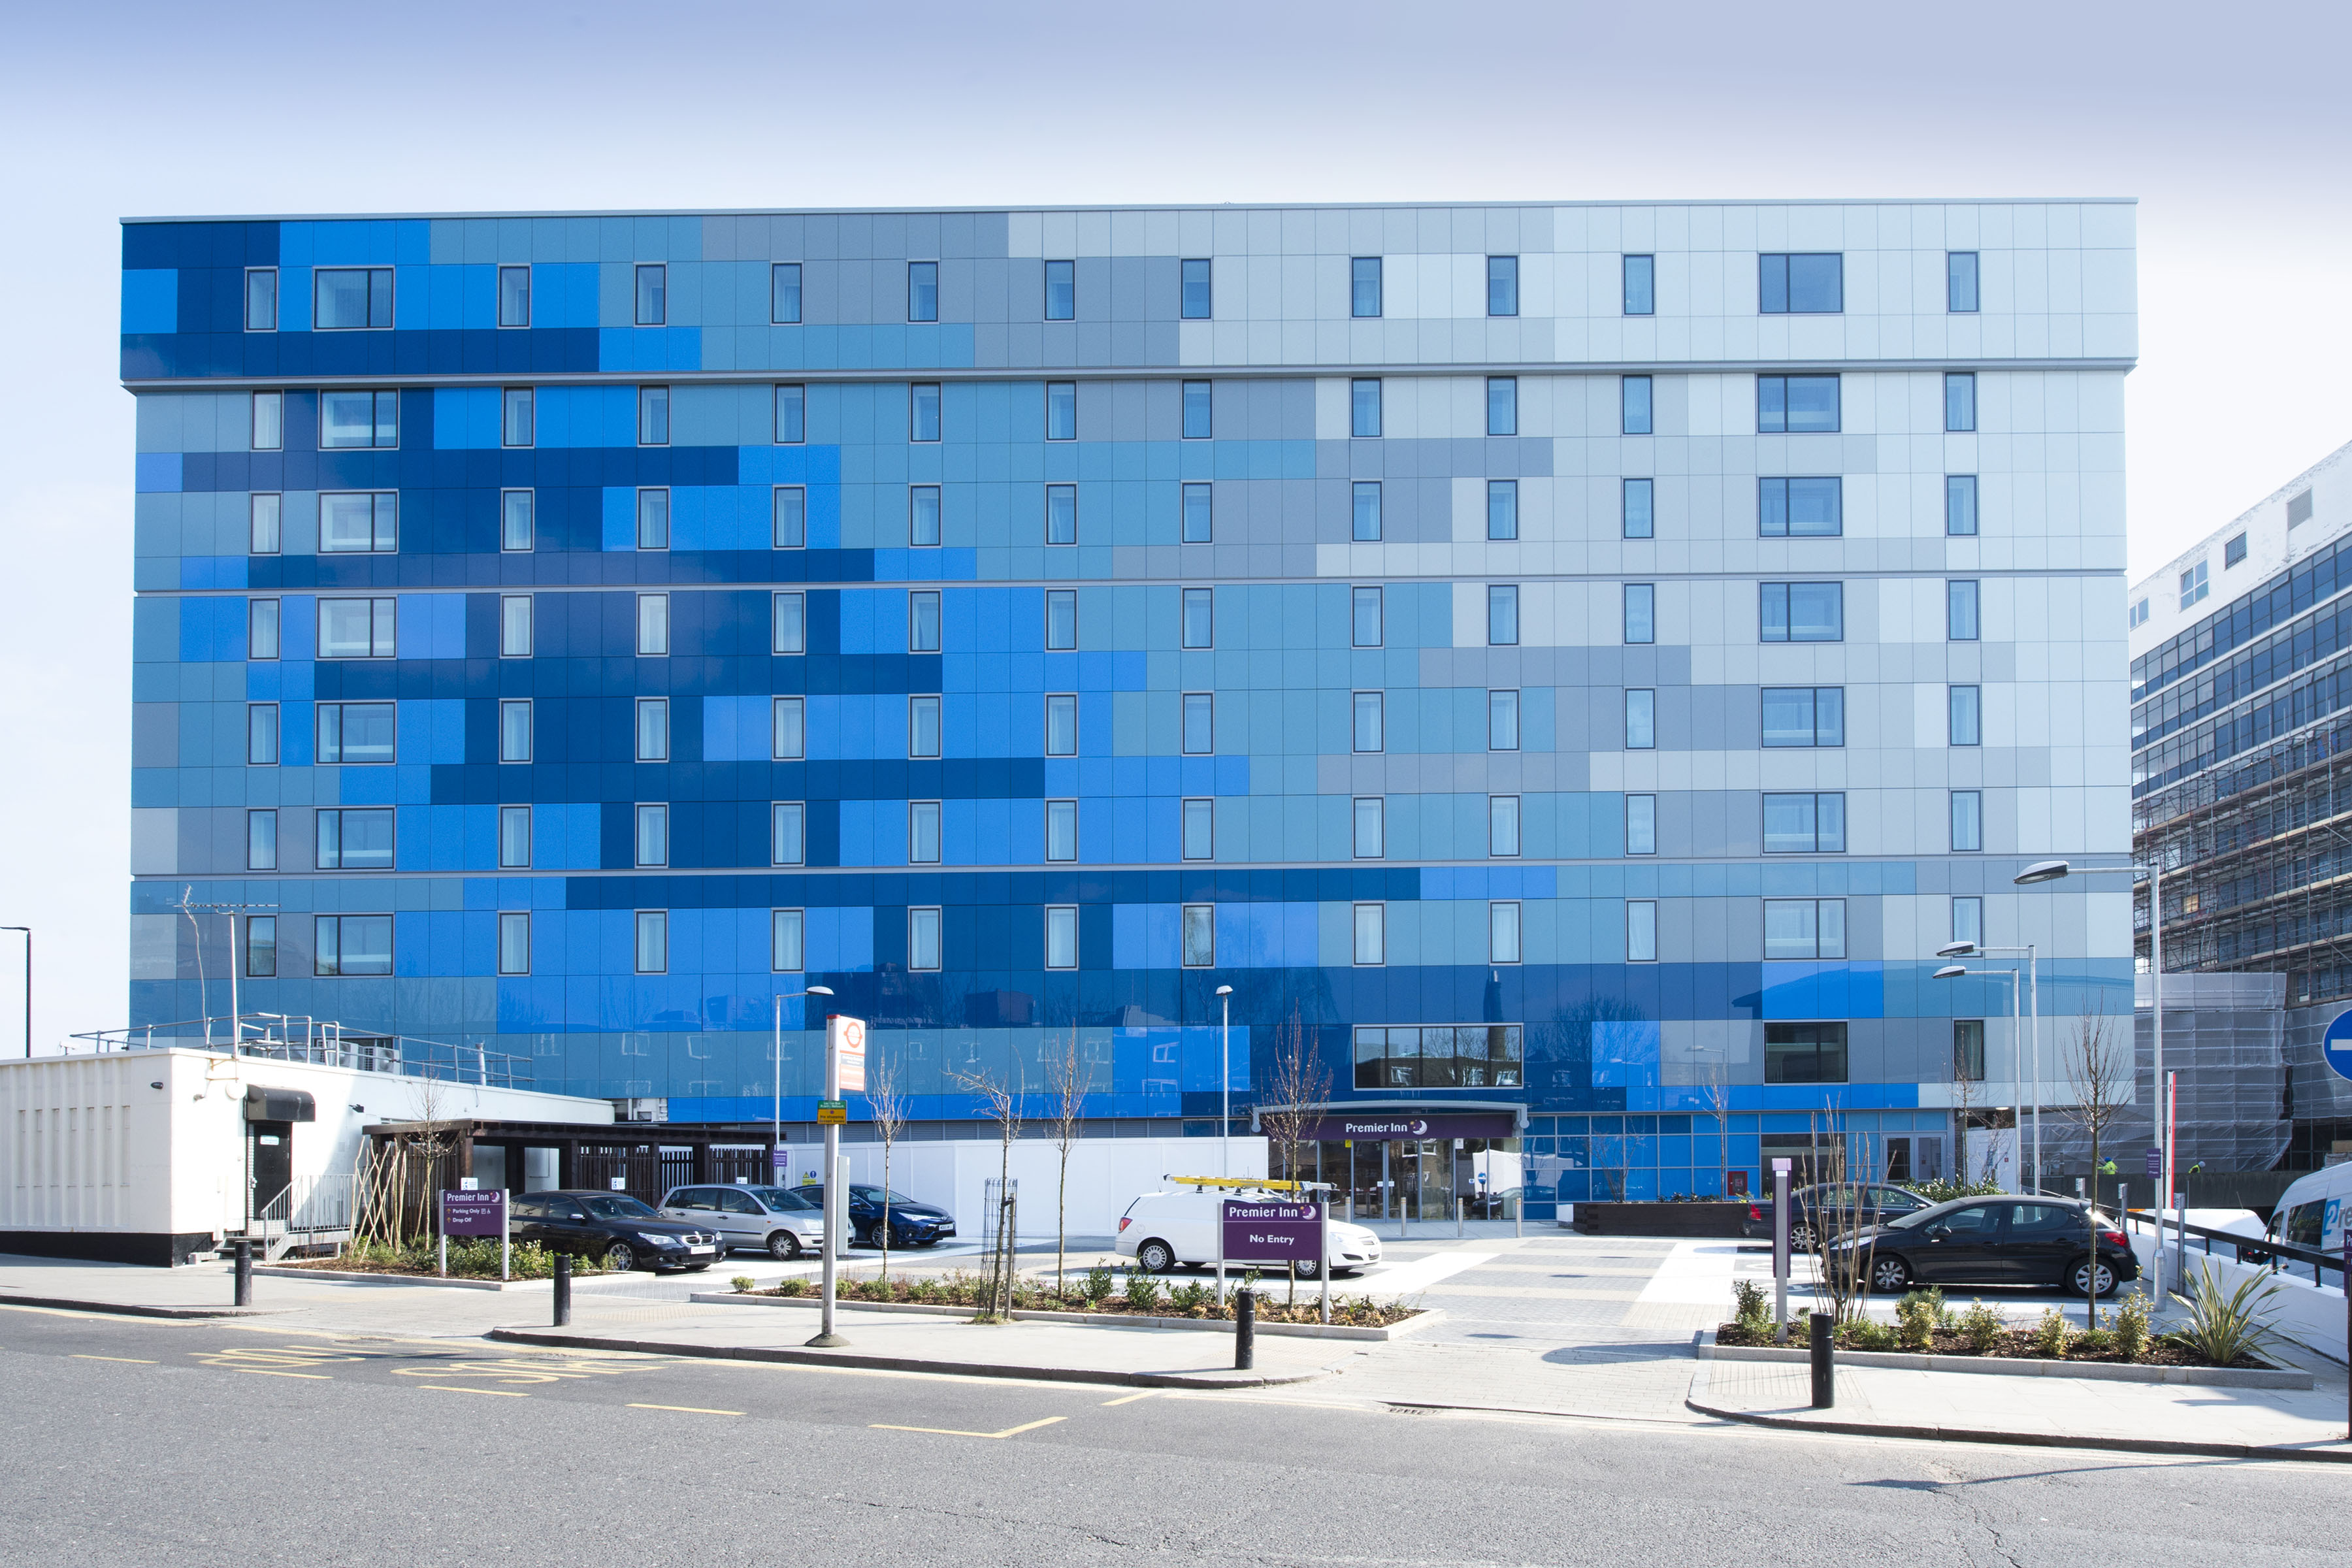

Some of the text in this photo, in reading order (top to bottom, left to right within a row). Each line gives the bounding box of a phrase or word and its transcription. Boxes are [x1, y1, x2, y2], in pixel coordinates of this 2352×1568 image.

[1346, 1122, 1407, 1132] Premier Inn
[447, 1193, 476, 1201] Premier
[1229, 1207, 1298, 1217] Premier Inn
[1249, 1234, 1294, 1245] No Entry
[390, 1358, 669, 1384] BUS
